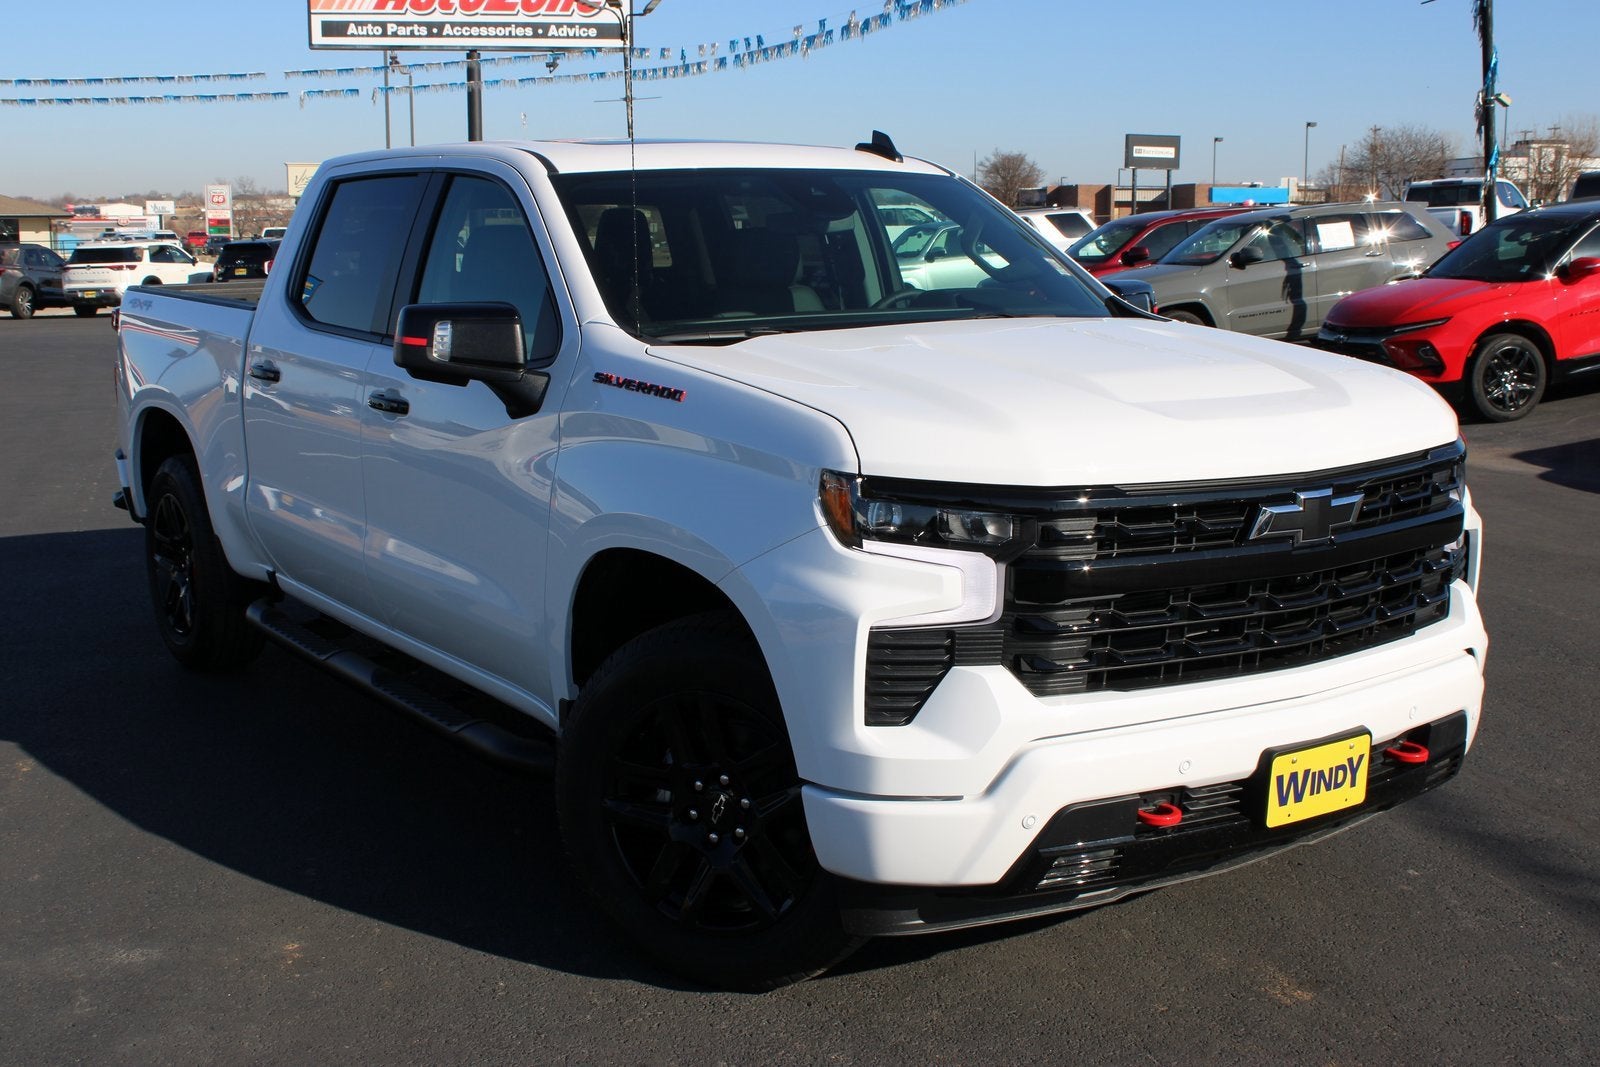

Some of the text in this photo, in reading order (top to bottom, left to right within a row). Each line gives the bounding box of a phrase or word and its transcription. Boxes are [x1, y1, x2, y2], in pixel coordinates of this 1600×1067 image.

[347, 23, 598, 37] Auto Parts Accessories Advice
[592, 371, 687, 403] SILVERADO
